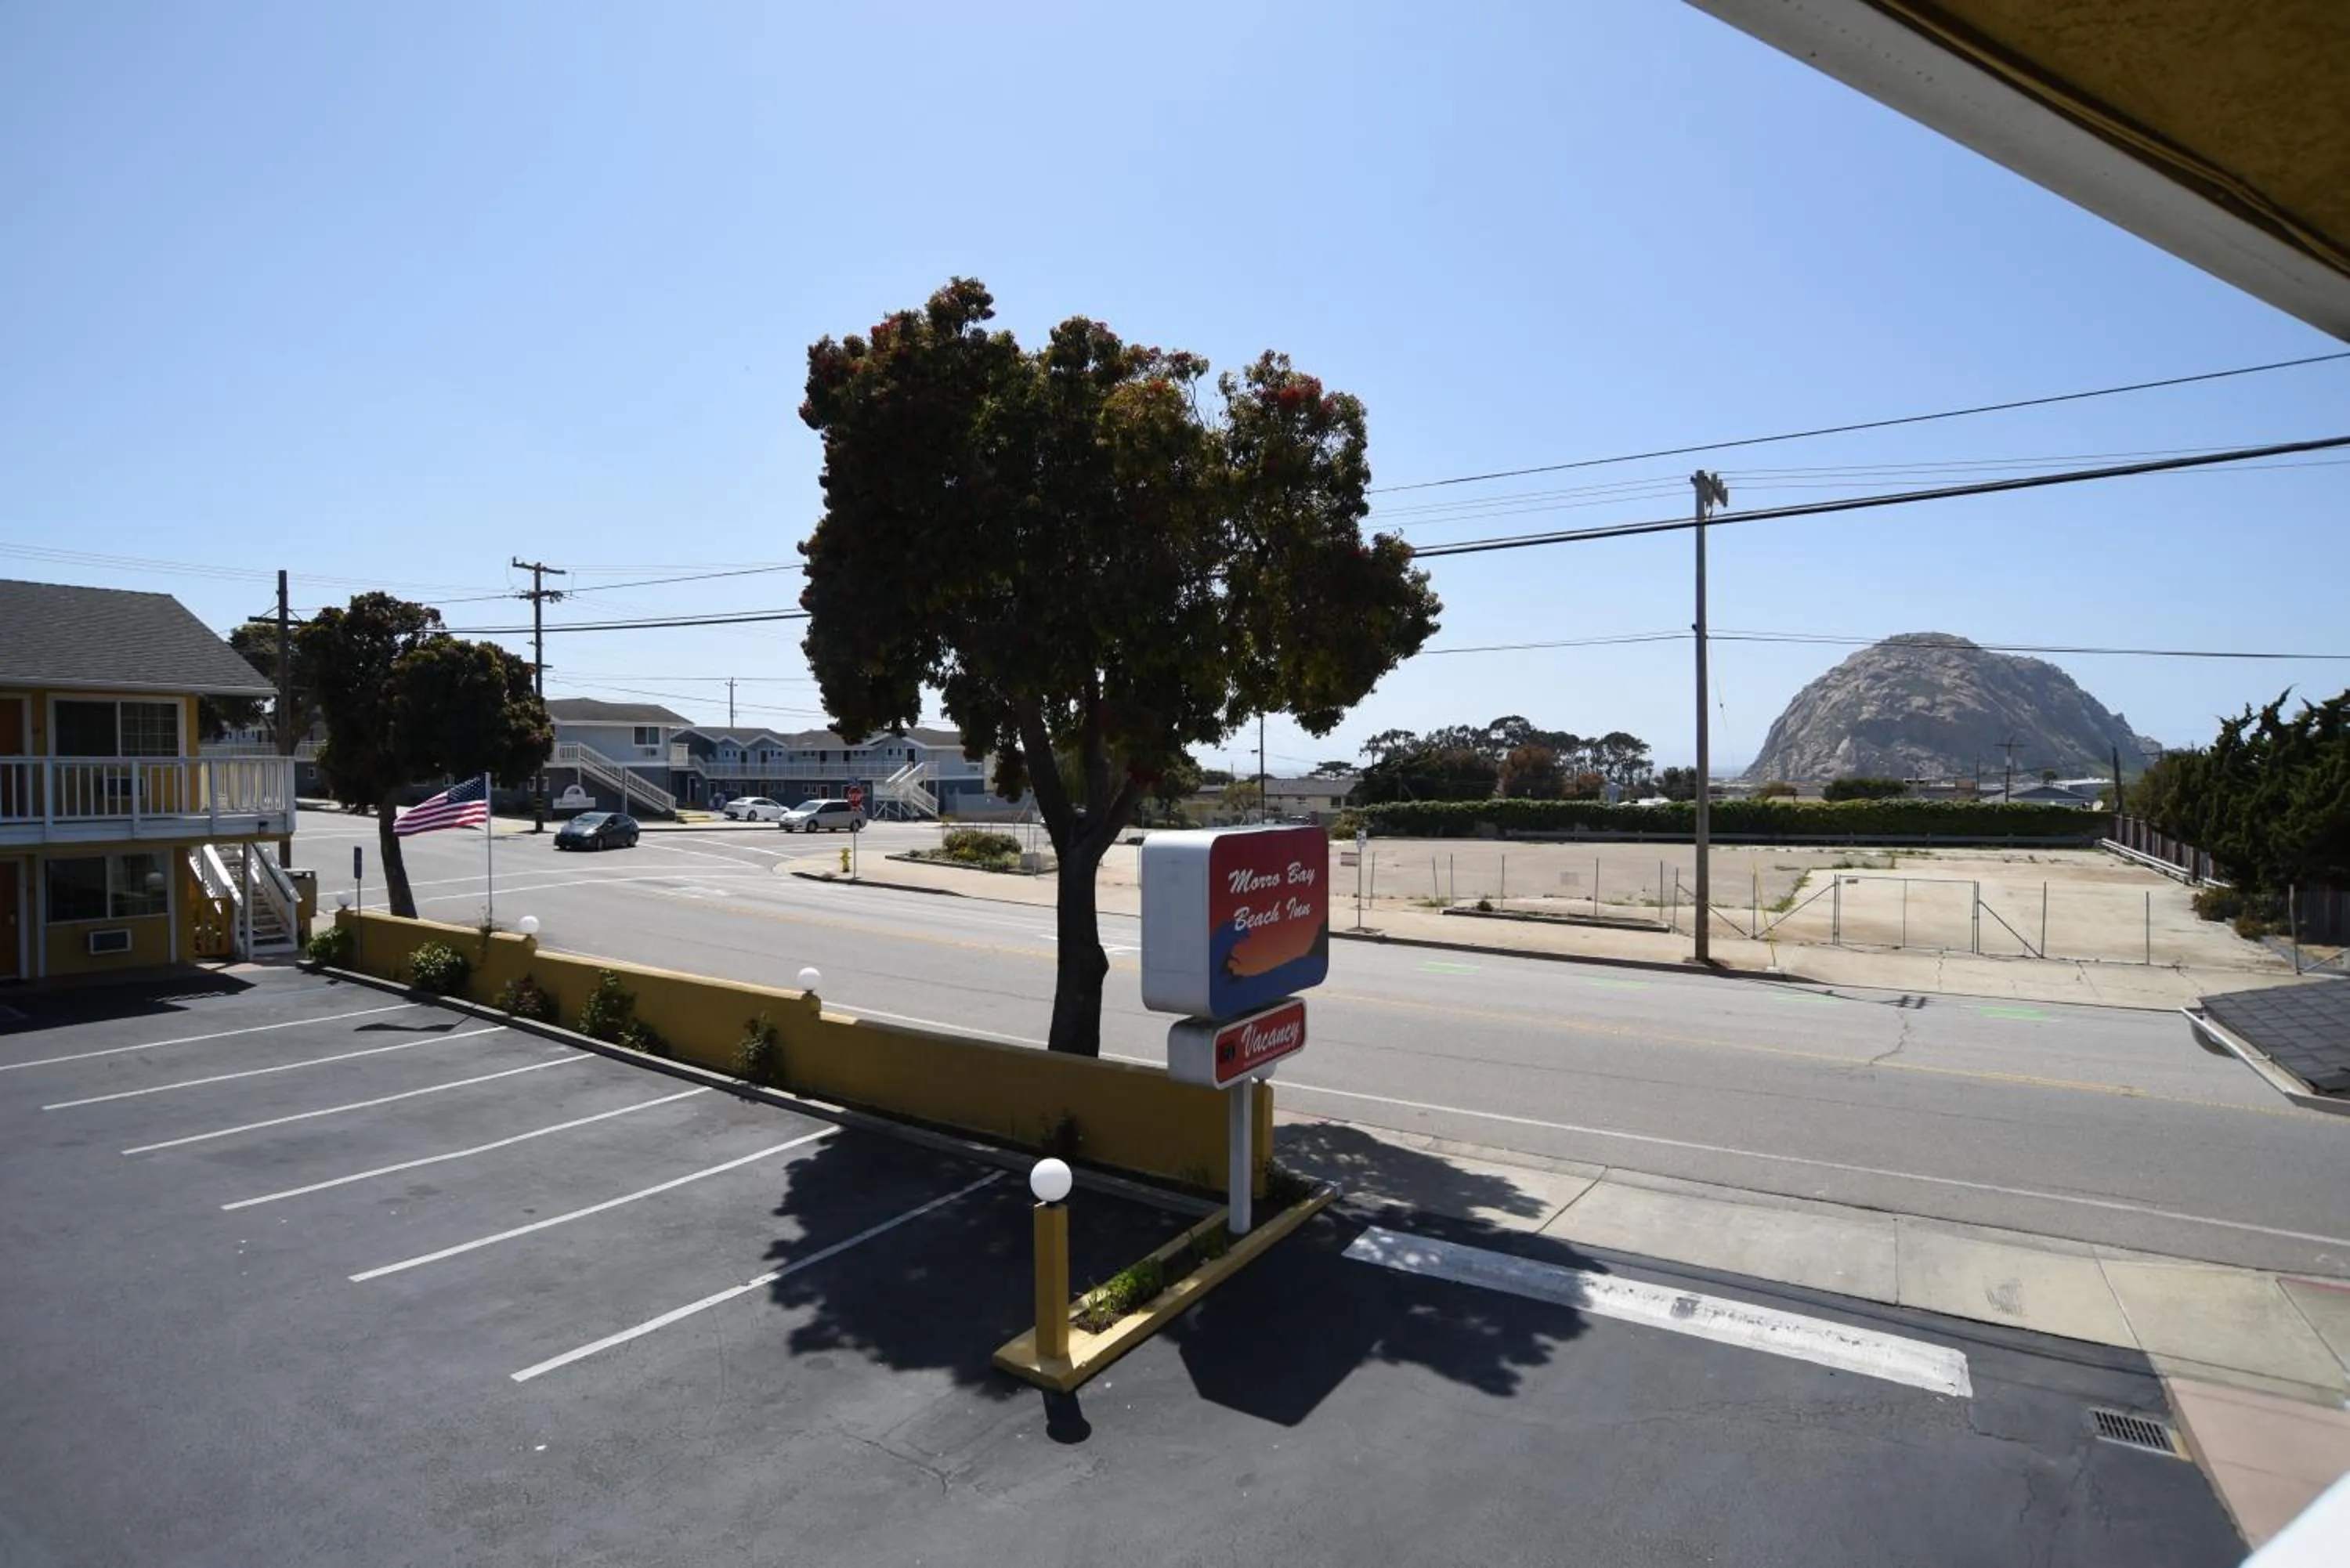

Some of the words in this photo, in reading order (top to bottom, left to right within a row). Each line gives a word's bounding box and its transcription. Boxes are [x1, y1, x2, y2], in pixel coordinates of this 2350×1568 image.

[1228, 869, 1280, 894] Morro
[1287, 862, 1315, 887] Bay
[1234, 901, 1280, 931] Beach
[1286, 897, 1311, 919] Inn
[1241, 1021, 1300, 1058] Vacancy
